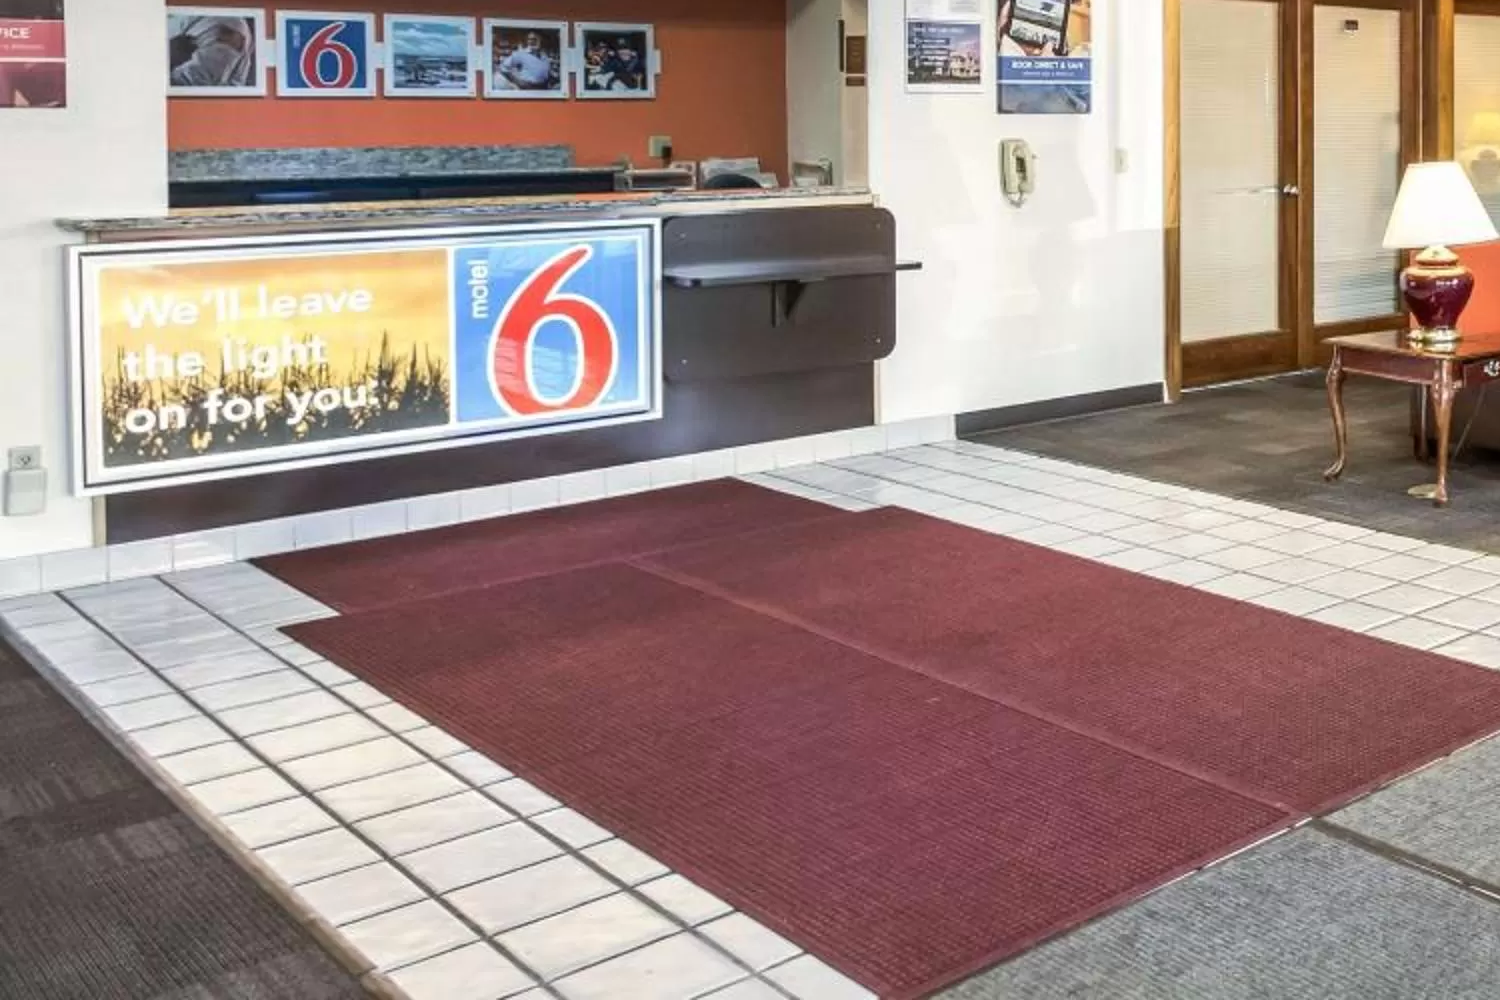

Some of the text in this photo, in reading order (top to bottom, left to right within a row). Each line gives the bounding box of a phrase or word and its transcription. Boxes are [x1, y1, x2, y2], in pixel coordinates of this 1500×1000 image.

[300, 21, 358, 88] 6
[123, 284, 374, 329] We'll leave
[467, 243, 619, 416] motel 6
[122, 332, 328, 382] the light
[124, 402, 187, 434] on
[202, 387, 272, 425] for
